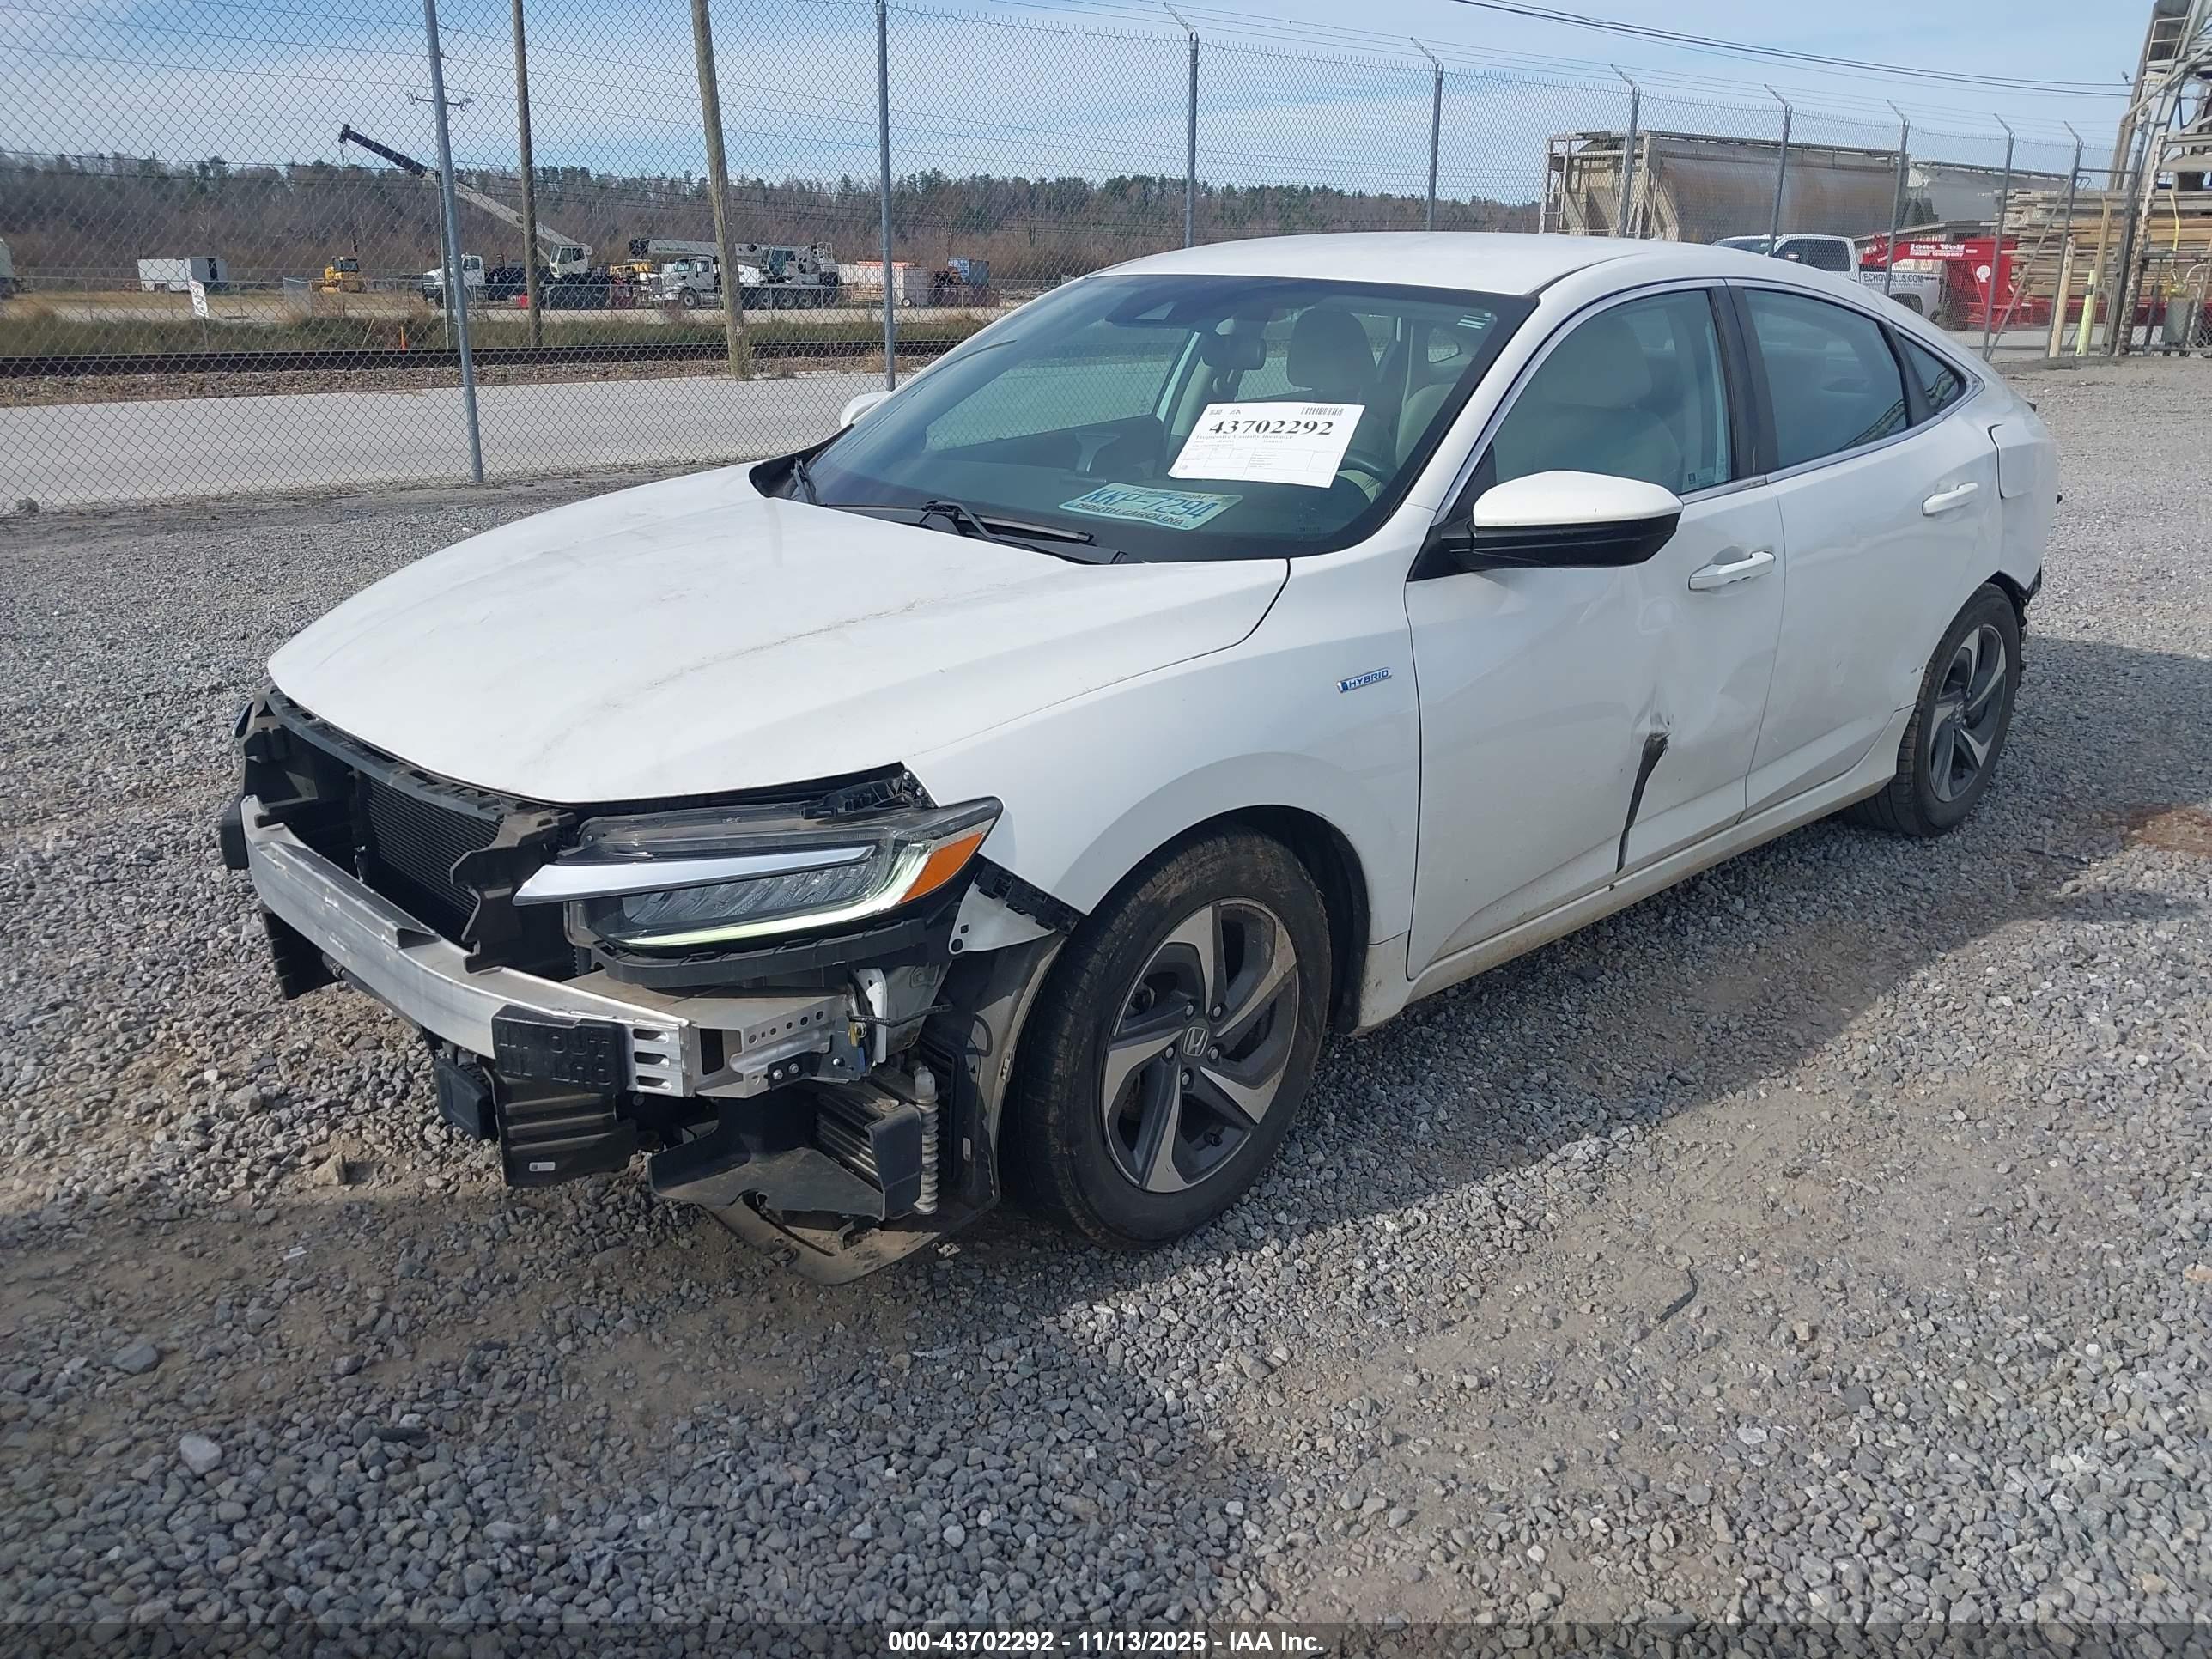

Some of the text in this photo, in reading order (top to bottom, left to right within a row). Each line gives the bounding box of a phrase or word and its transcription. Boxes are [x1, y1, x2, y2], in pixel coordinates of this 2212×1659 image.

[1863, 273, 1923, 283] ECHOALLS.COM
[1209, 420, 1334, 435] 43702292
[1349, 670, 1389, 688] HYBRID
